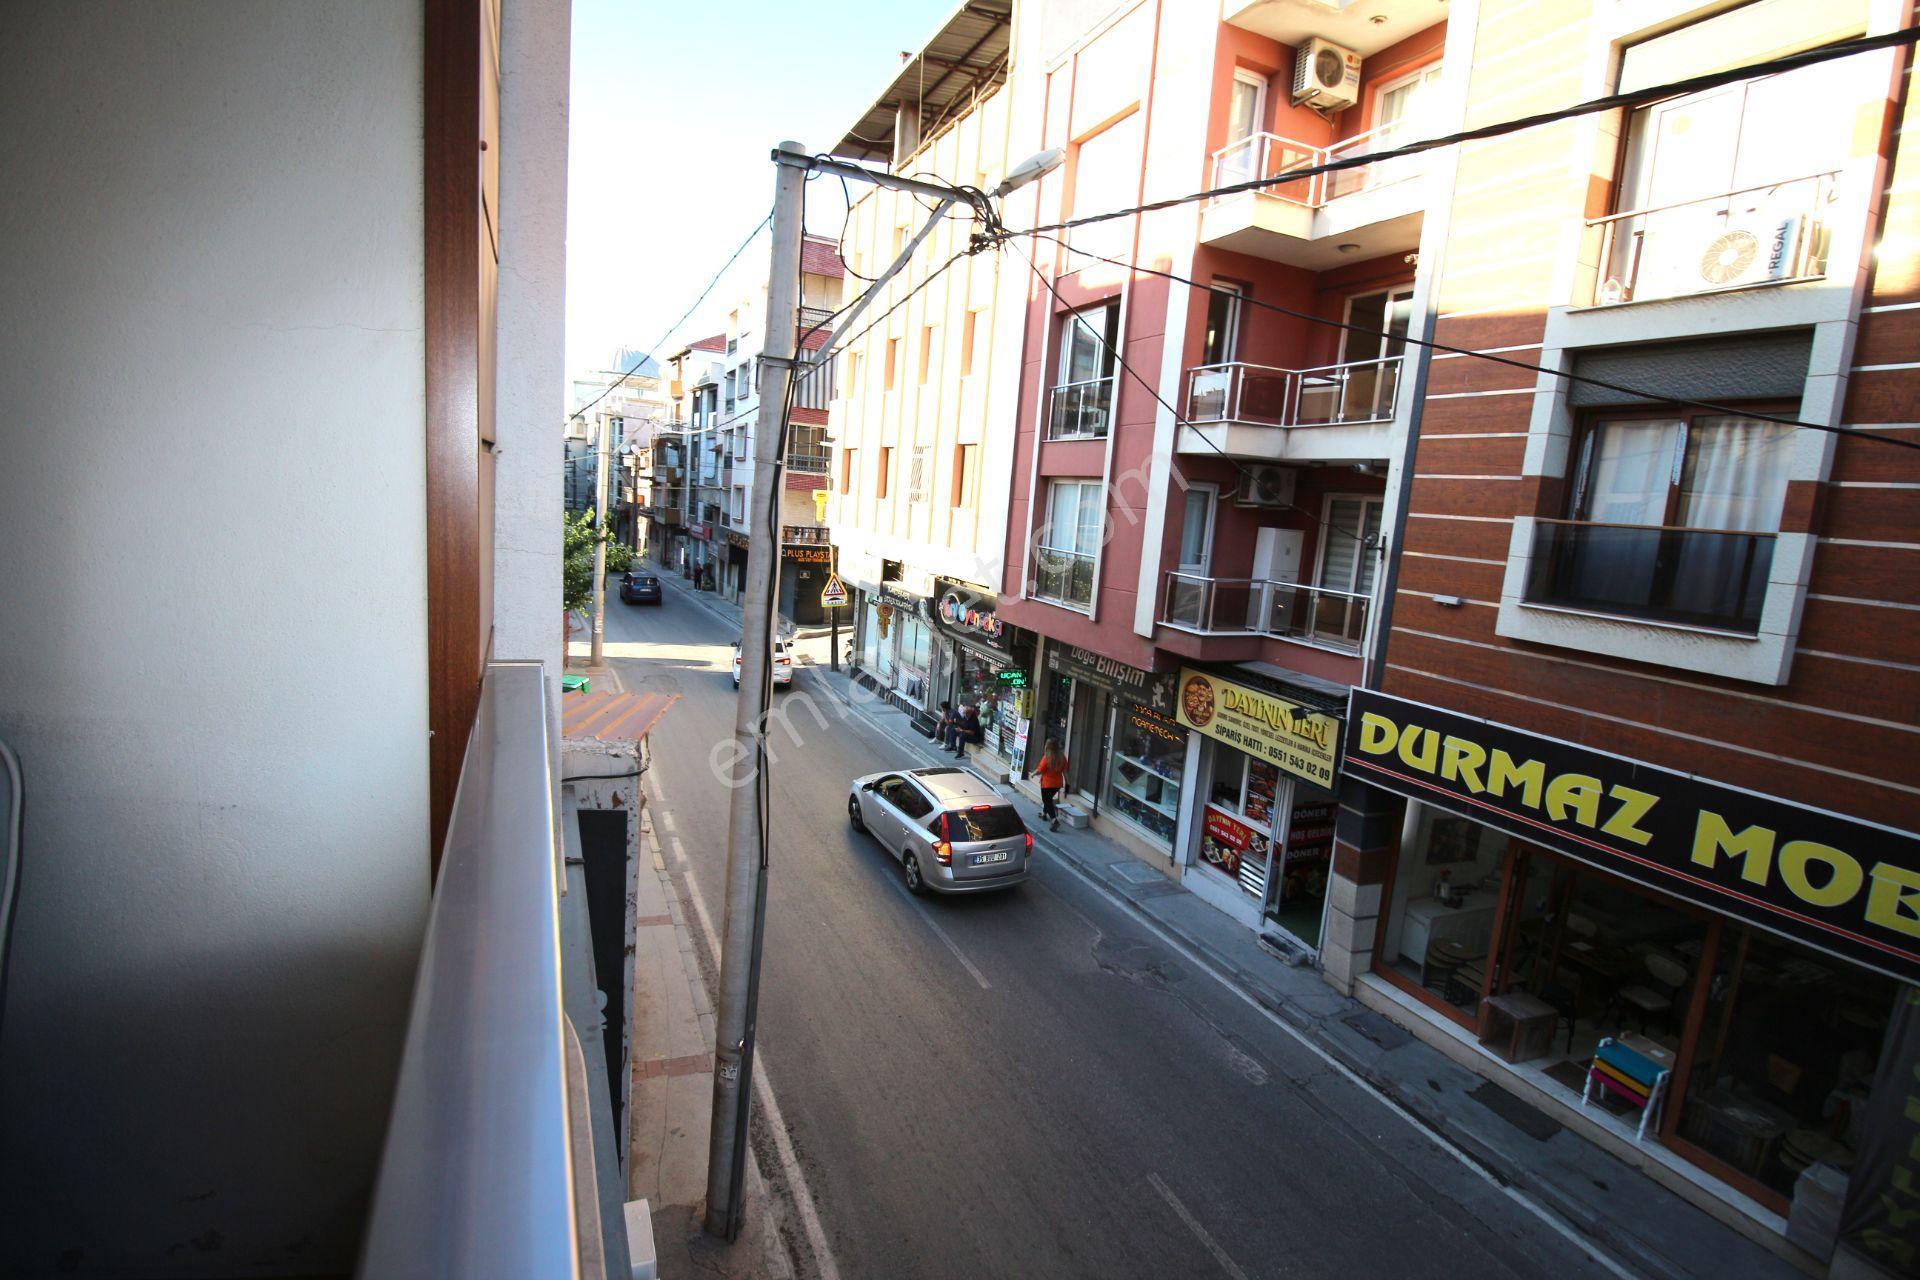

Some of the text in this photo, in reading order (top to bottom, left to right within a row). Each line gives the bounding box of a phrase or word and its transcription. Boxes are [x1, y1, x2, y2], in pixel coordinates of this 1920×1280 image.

[1768, 220, 1790, 270] REGAL
[787, 549, 804, 558] PLUS
[1215, 723, 1242, 744] SİPARİŞ
[1243, 735, 1263, 753] HATTI
[1268, 746, 1287, 763] 0551
[1289, 754, 1305, 770] 543
[1306, 762, 1318, 776] 02
[1319, 768, 1331, 781] 09
[1359, 711, 1661, 846] DURMAZ
